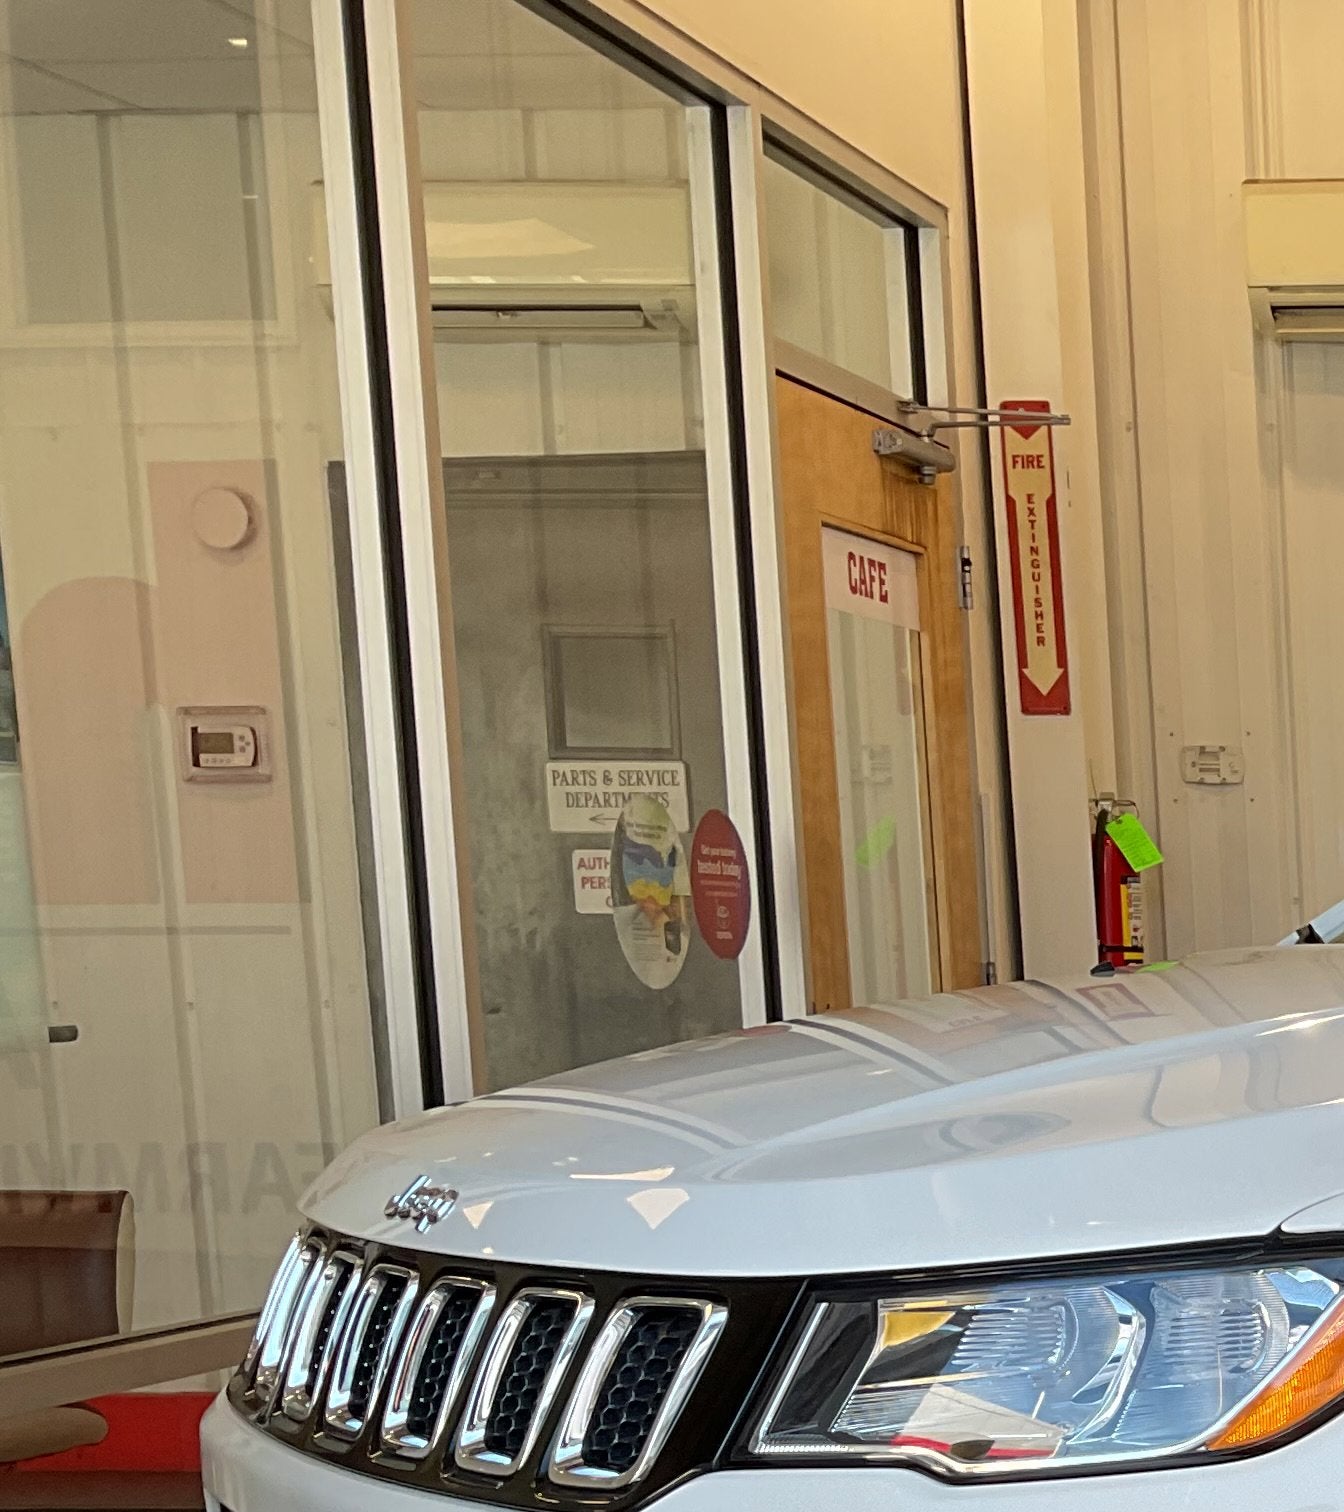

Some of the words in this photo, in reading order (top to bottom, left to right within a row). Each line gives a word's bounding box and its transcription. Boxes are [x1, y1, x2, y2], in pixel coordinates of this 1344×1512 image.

[1011, 453, 1046, 471] FIRE
[846, 551, 889, 604] CAFE
[1025, 493, 1047, 648] EXTINGUISHER
[551, 769, 597, 787] PARTS
[603, 770, 614, 786] &
[618, 769, 681, 787] SERVICE
[565, 791, 670, 809] DEPARTMTS
